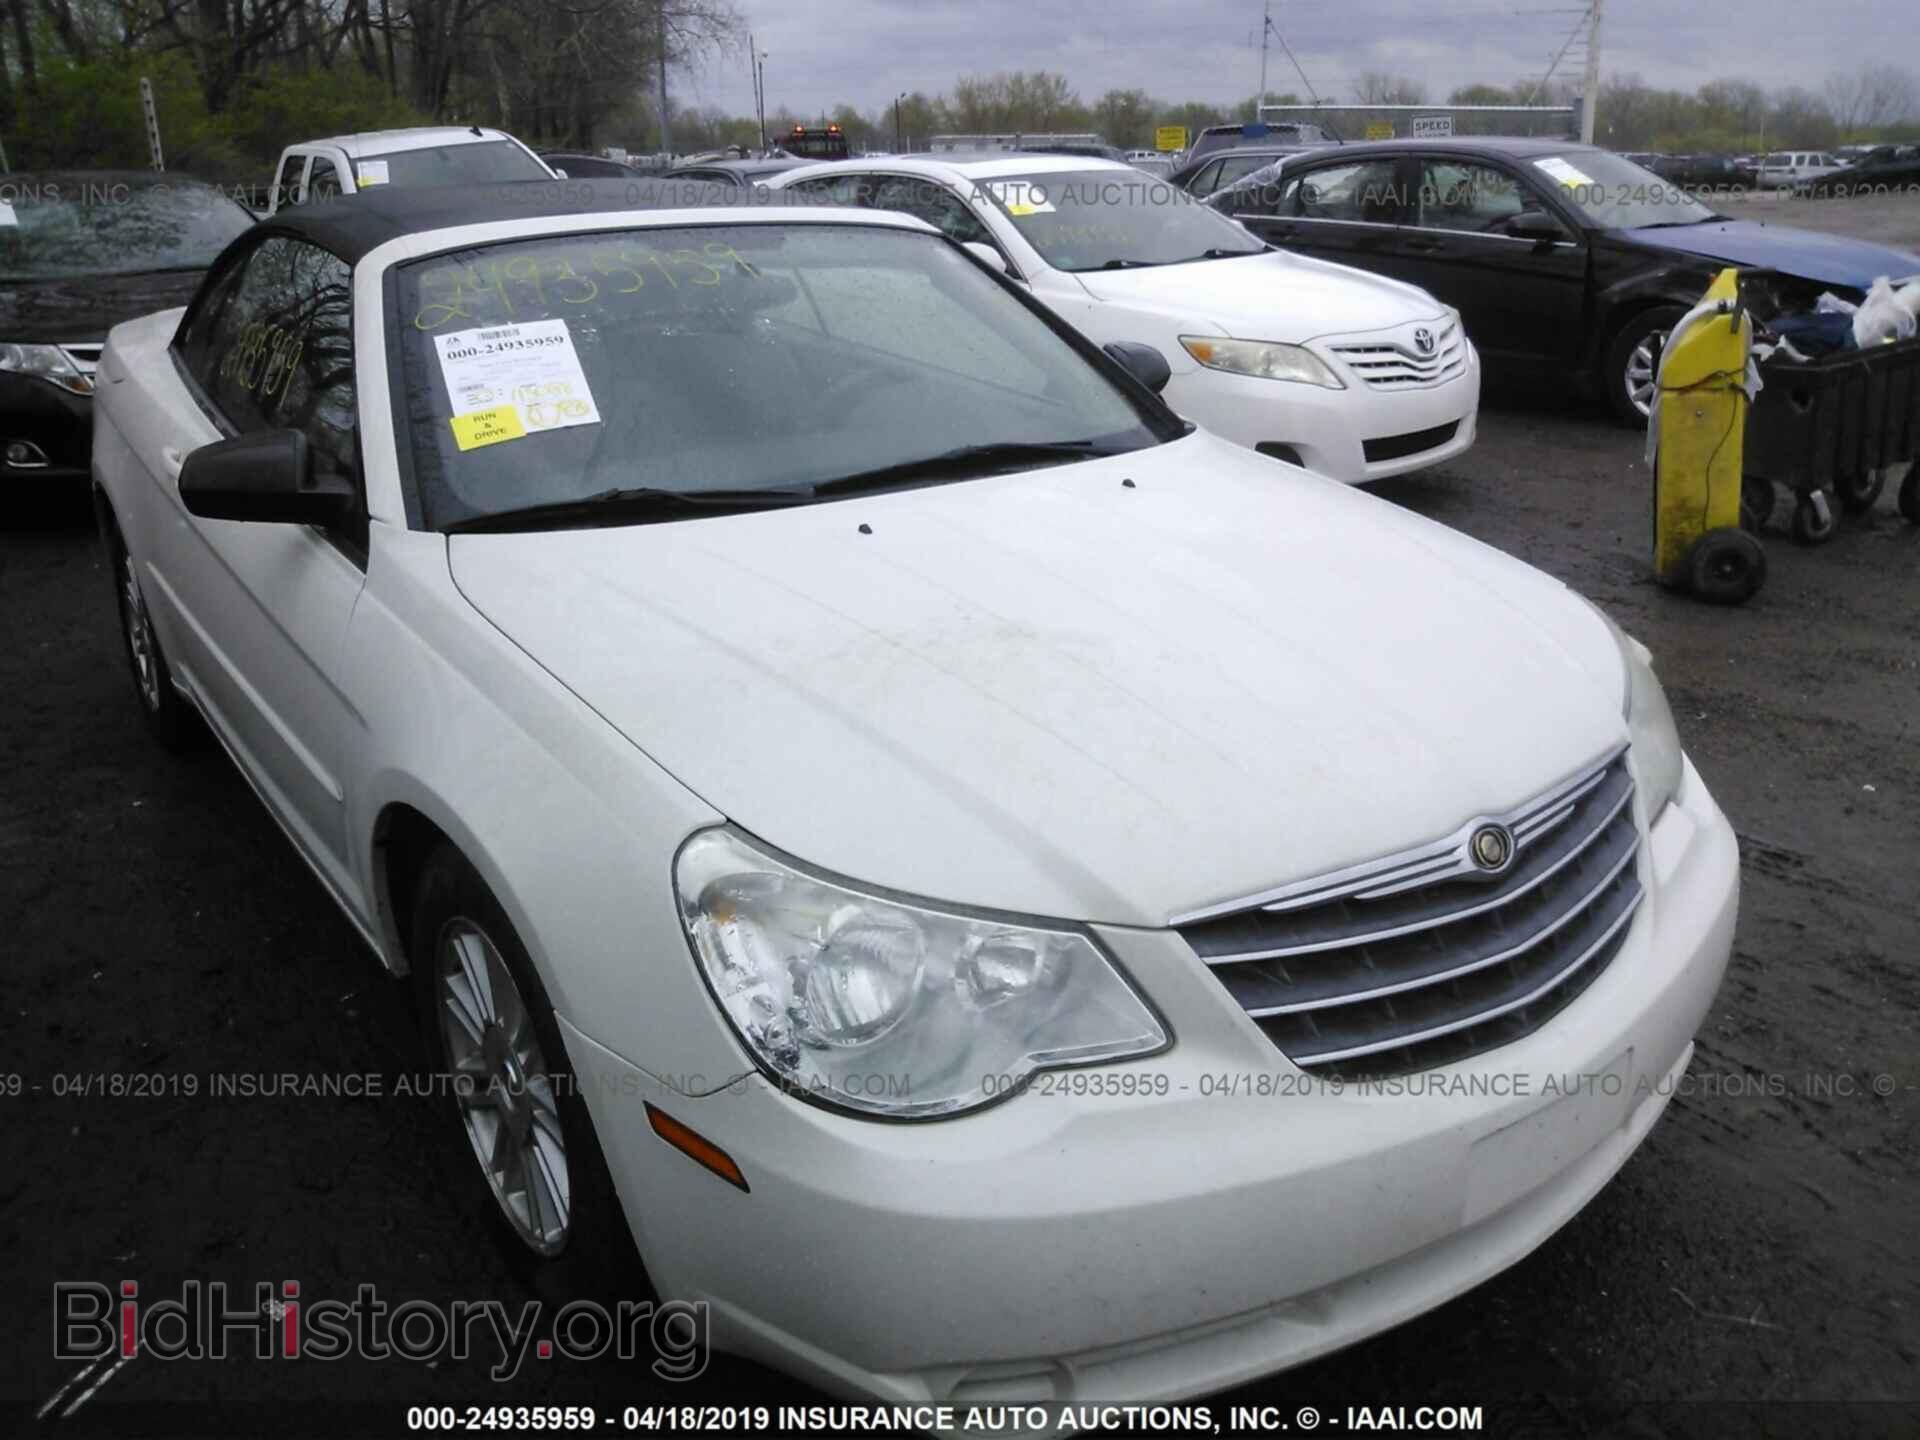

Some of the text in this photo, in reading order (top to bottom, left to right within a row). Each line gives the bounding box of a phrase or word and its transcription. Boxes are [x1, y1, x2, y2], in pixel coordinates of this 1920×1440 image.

[1416, 121, 1450, 131] SPEED
[447, 334, 565, 361] 000-24935959
[473, 413, 497, 423] RUN
[474, 427, 507, 440] DRIVE
